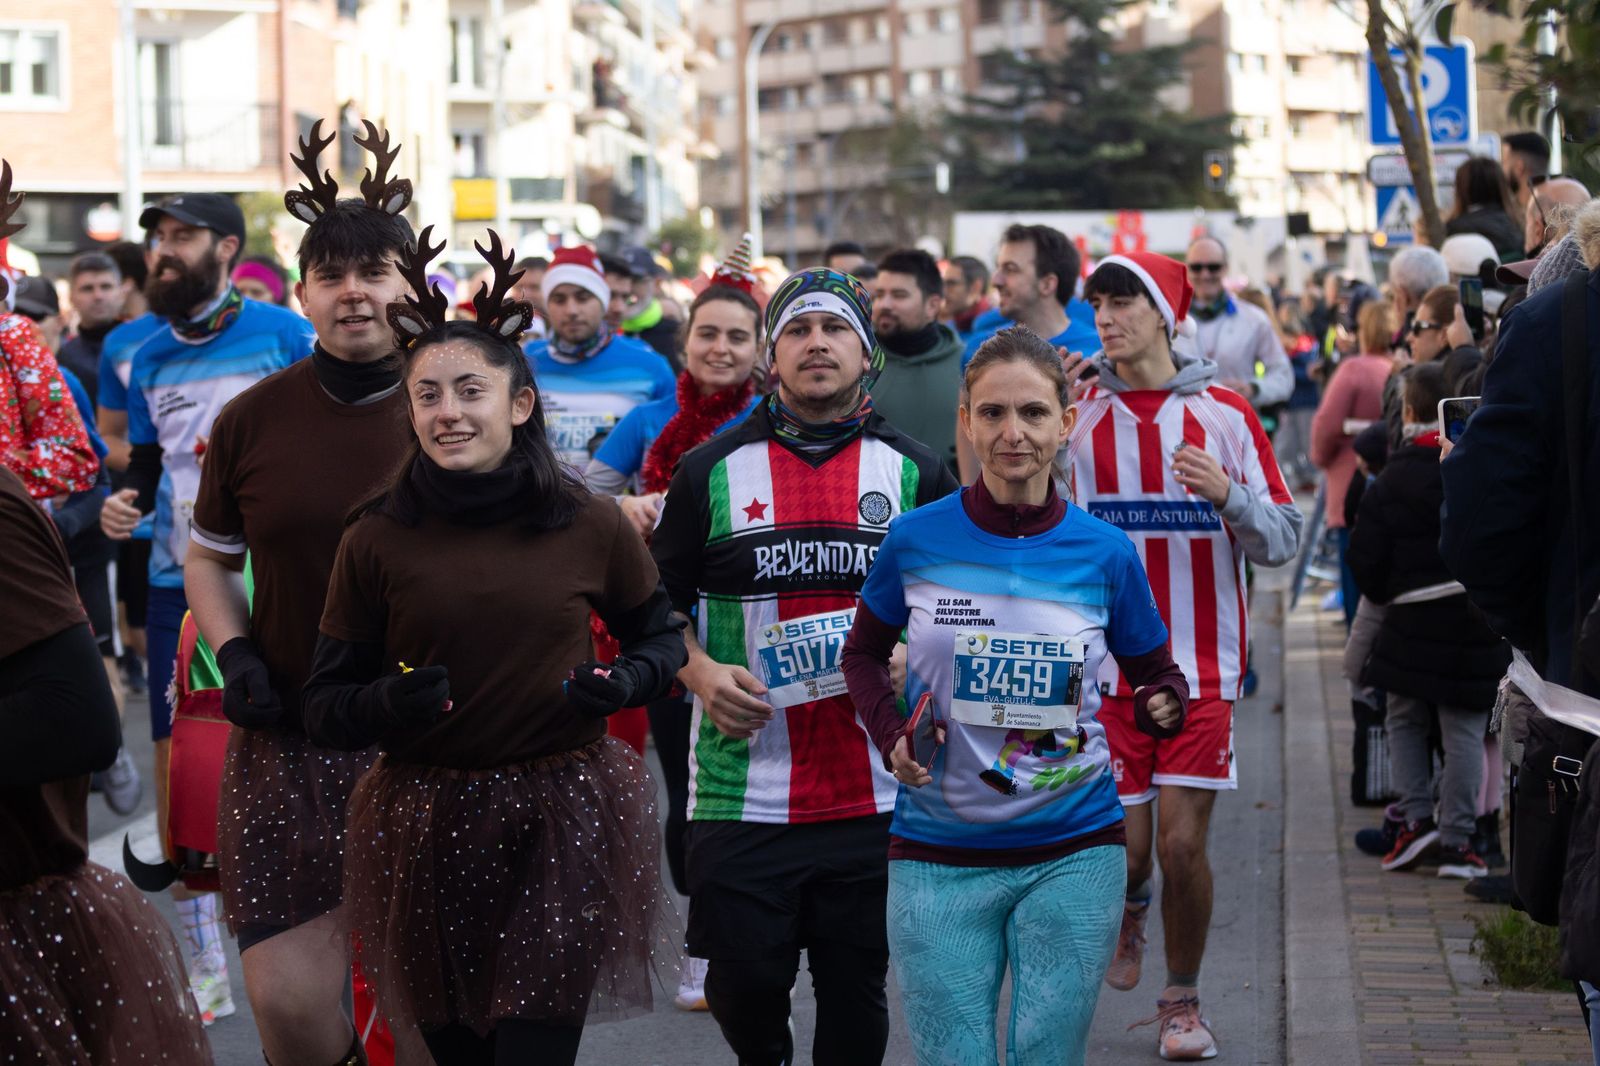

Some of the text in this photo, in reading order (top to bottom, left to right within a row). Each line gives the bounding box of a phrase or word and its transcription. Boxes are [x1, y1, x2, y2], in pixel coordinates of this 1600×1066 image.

[1128, 511, 1148, 523] DE
[1151, 509, 1218, 523] ASTURIAS
[937, 598, 972, 606] XLI SAN
[935, 608, 981, 616] SILVESTRE
[933, 617, 996, 627] SALMANTINA
[990, 638, 1073, 657] SETEL
[775, 633, 845, 678] 5072
[969, 658, 1053, 699] 3459
